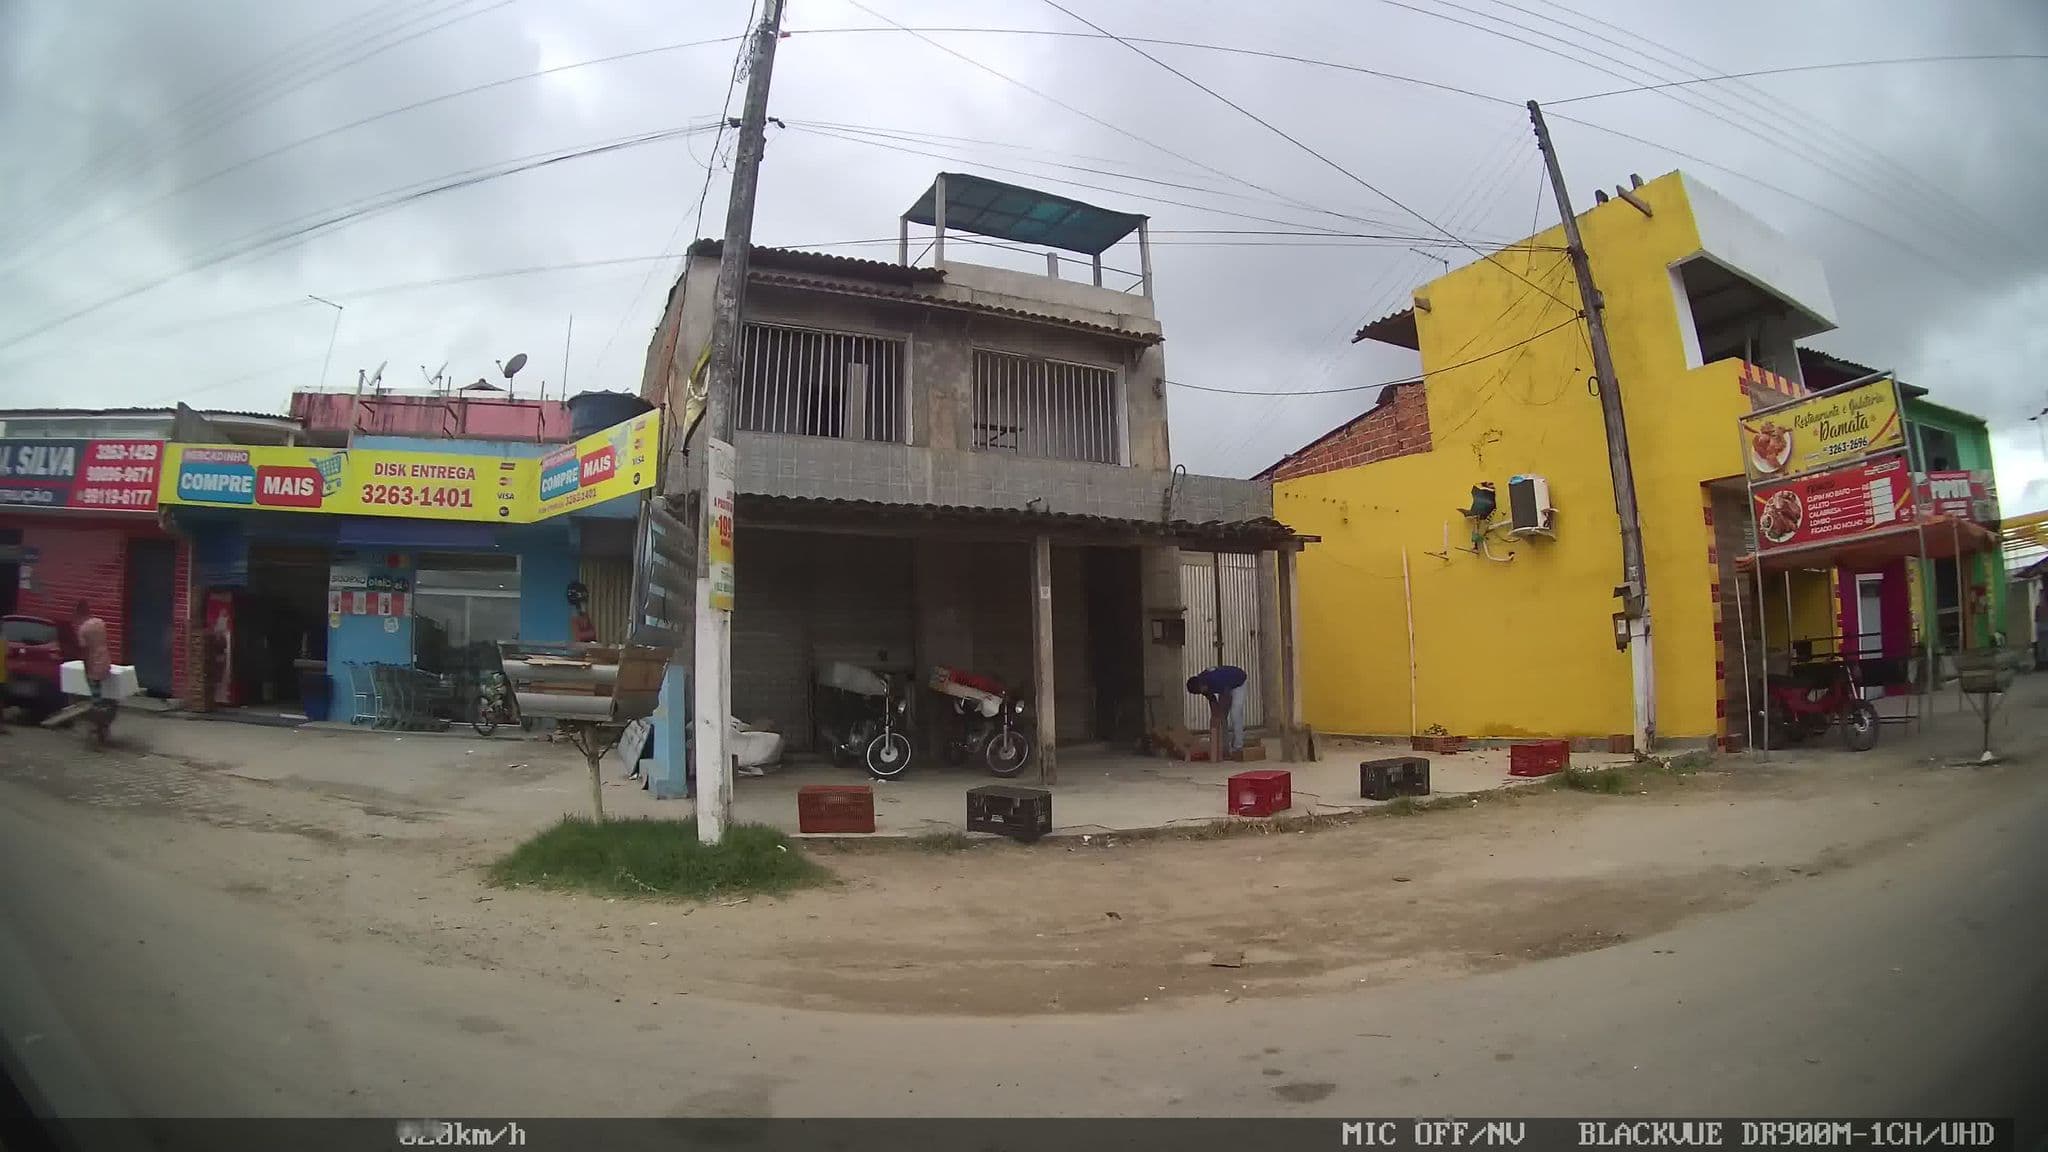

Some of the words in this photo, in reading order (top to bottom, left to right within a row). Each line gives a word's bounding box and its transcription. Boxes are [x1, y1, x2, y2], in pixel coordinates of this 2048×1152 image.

[1819, 411, 1869, 442] Damata
[183, 449, 248, 462] MERCADINHO
[1828, 438, 1868, 455] 3263-2696
[16, 446, 75, 476] SILVA
[374, 463, 406, 477] DISK
[411, 465, 476, 481] ENTREGA
[541, 467, 579, 493] COMPRE
[583, 455, 611, 479] MAIS
[181, 472, 253, 493] COMPRE
[263, 476, 314, 496] MAIS
[361, 484, 473, 508] 3263-1401
[496, 492, 515, 500] VISA
[1807, 500, 1830, 511] GALETO
